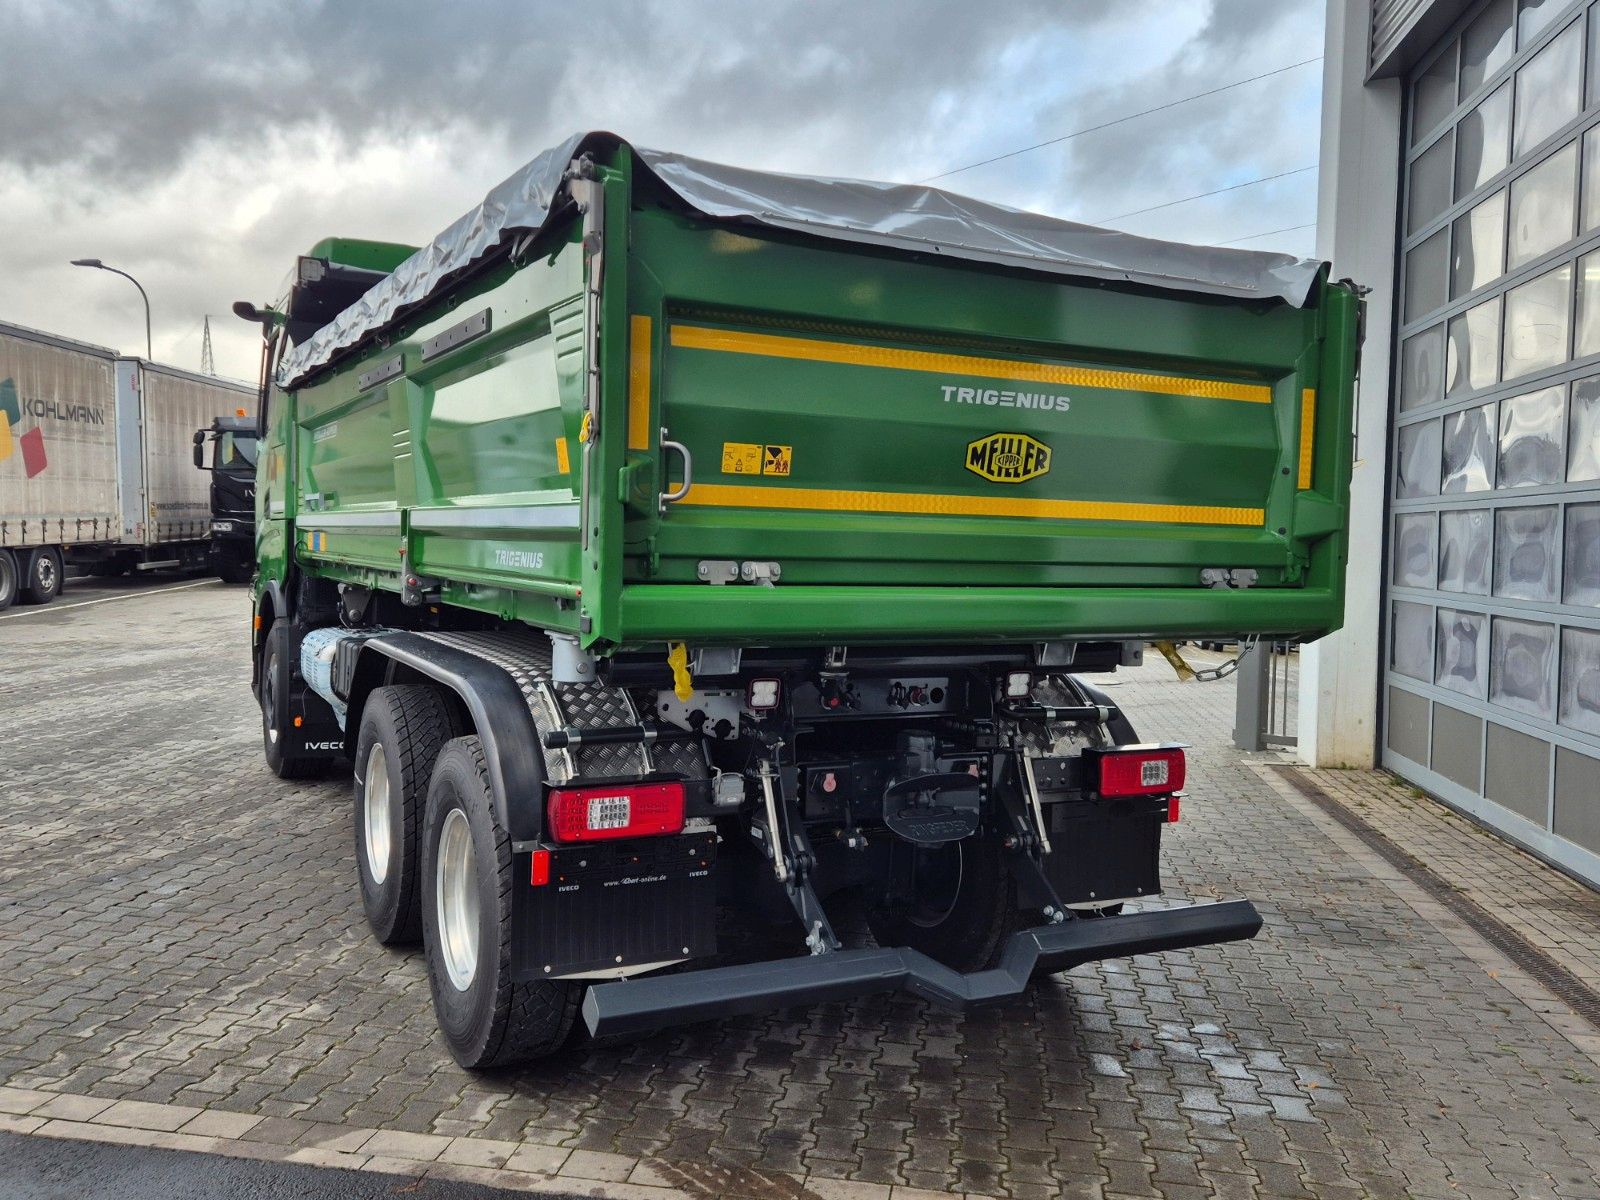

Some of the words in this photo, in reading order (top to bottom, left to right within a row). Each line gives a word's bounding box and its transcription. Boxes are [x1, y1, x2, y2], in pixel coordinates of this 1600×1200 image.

[941, 385, 1071, 412] TRIGENIUS
[22, 398, 105, 426] KOHLMANN
[970, 438, 1048, 478] MEILLER
[495, 549, 544, 569] TRIGENIUS
[689, 870, 708, 878] IVECO
[559, 884, 580, 893] IVECO
